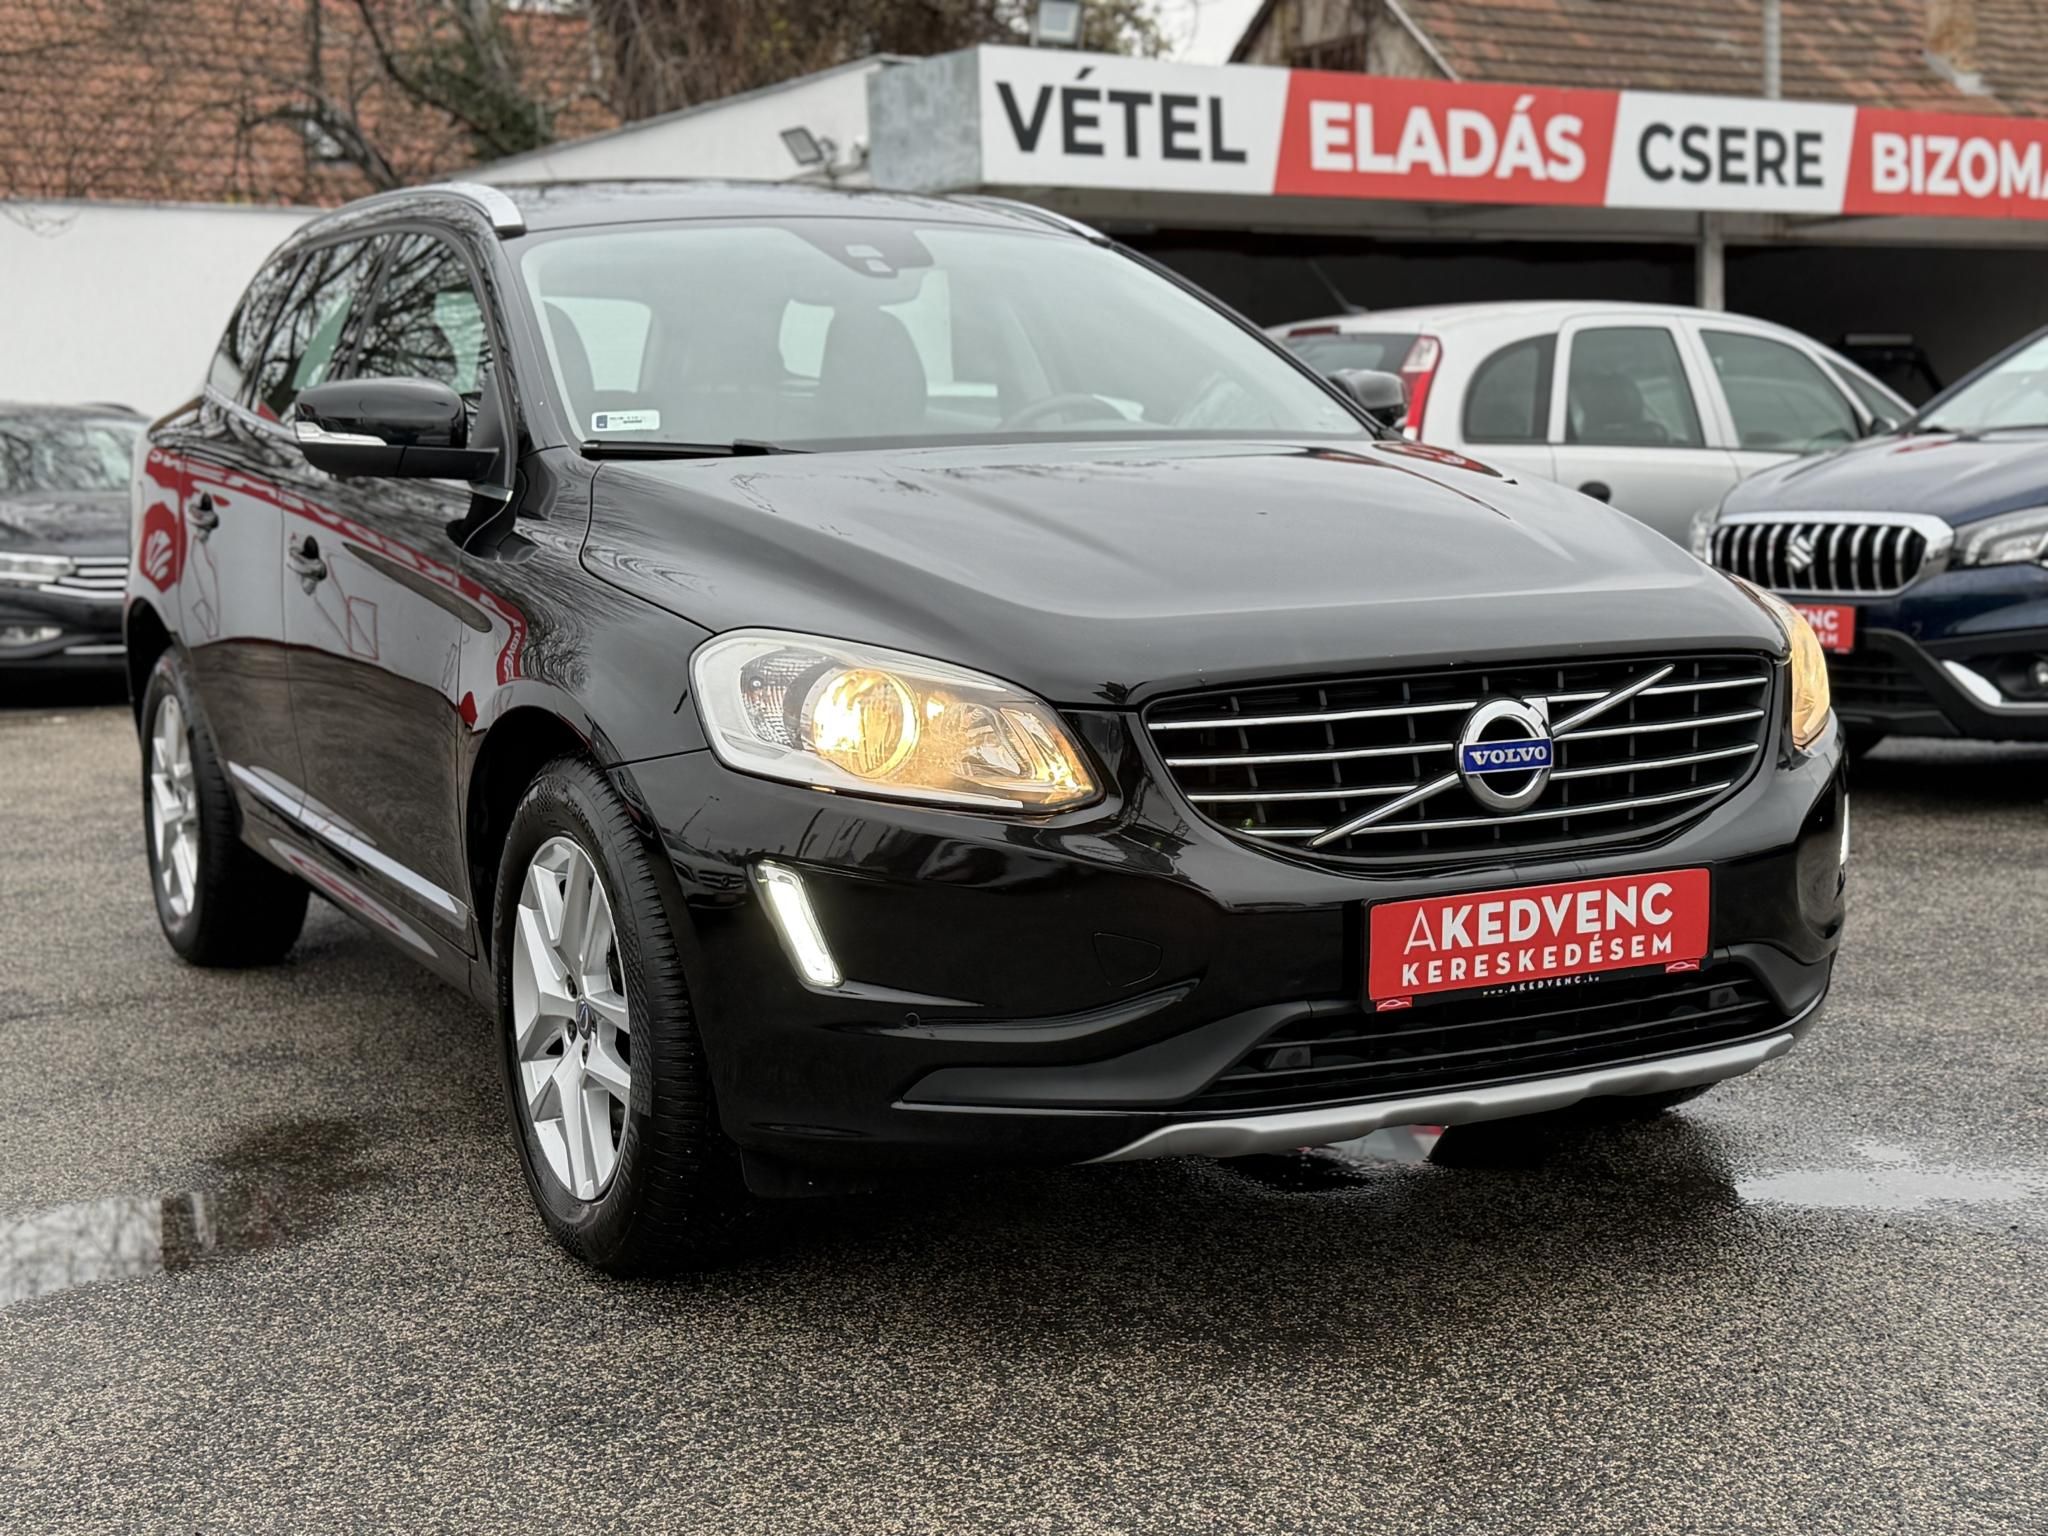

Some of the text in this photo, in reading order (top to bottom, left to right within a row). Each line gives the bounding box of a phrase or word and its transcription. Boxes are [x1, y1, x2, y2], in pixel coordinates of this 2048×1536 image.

[995, 66, 2048, 200] VÉTEL ELADÁS CSERE BIZOM
[1469, 745, 1548, 765] VOLVO
[1402, 932, 1673, 987] KERESKEDÉSEM
